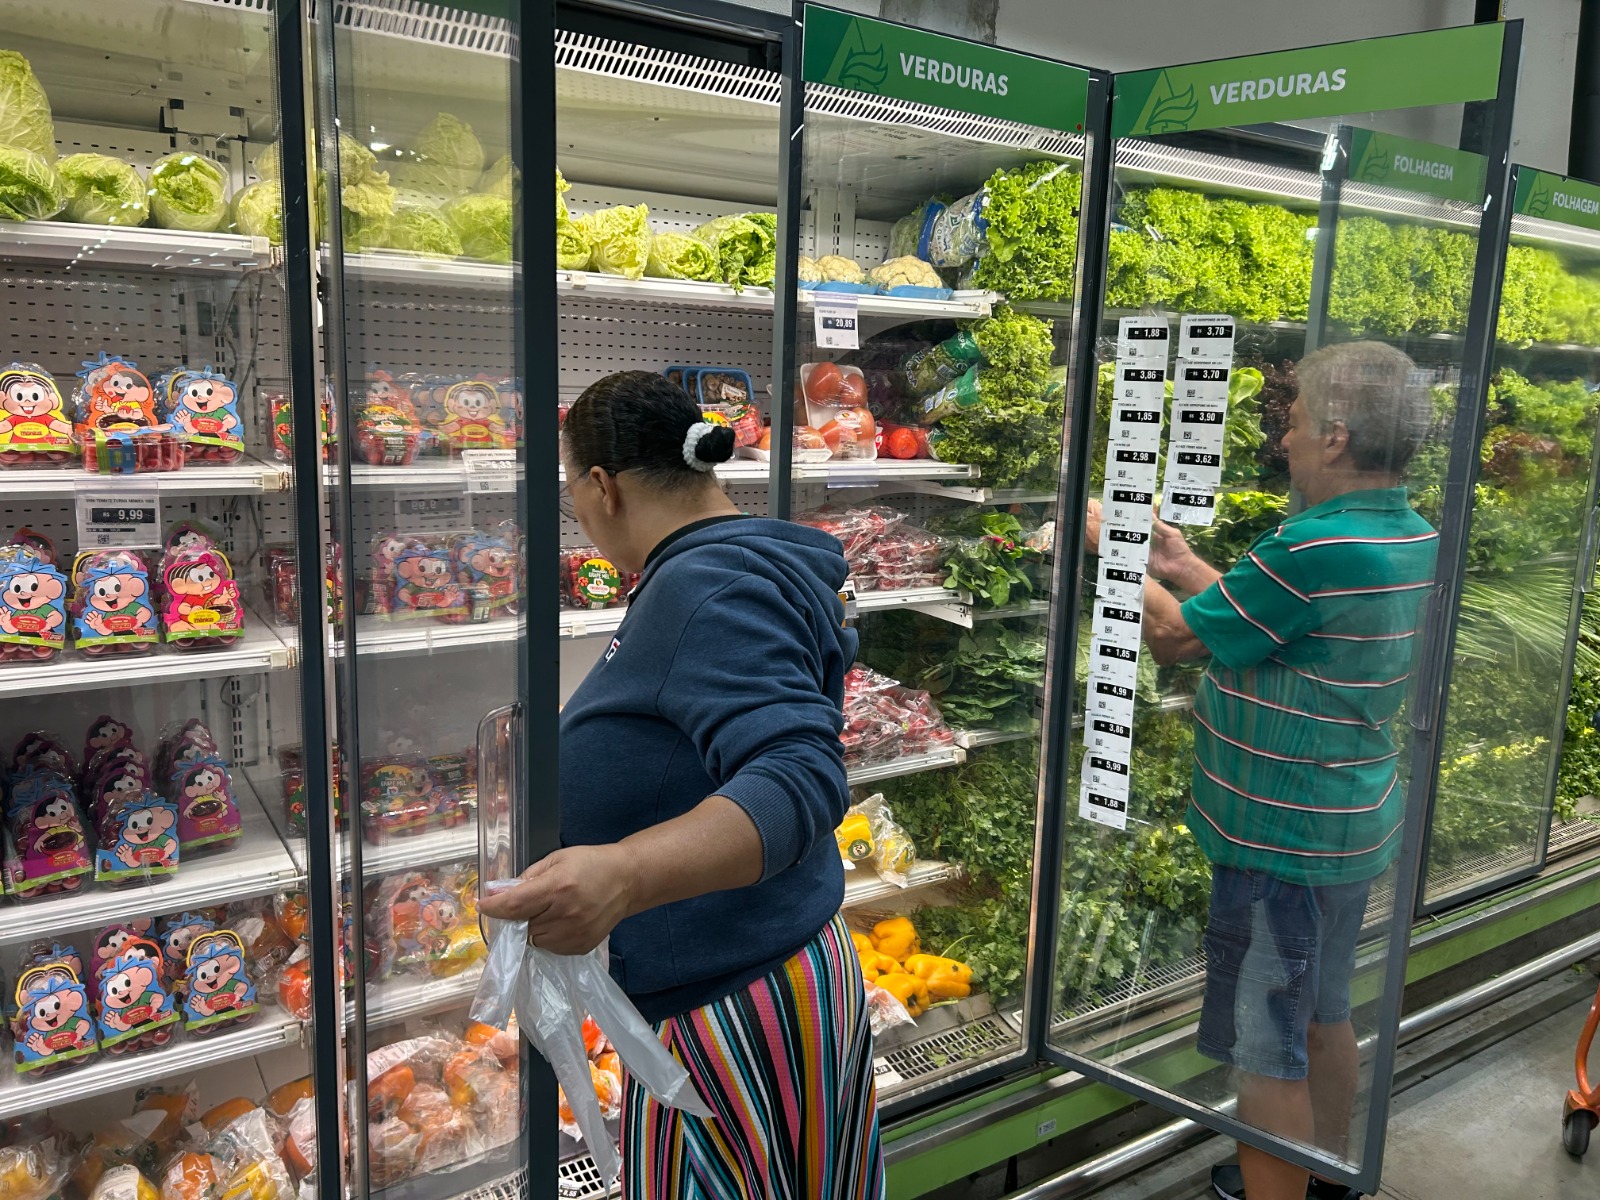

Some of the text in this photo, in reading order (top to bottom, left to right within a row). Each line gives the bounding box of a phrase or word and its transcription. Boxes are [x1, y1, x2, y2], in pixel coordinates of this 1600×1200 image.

[899, 52, 1009, 97] VERDURAS
[1209, 69, 1347, 105] VERDURAS
[1393, 154, 1454, 181] FOLHAGEM
[1552, 191, 1599, 215] FOLHAGEM
[835, 318, 852, 328] 20,89
[1144, 328, 1160, 338] 1,88
[1207, 326, 1225, 336] 3,70
[1139, 371, 1156, 380] 3,86
[1202, 370, 1220, 379] 3,70
[1137, 412, 1153, 422] 1,85
[1199, 412, 1216, 422] 3,90
[1132, 452, 1149, 462] 2,98
[1195, 454, 1212, 464] 3,62
[1129, 492, 1145, 502] 1,85
[118, 509, 143, 521] 9,99
[1125, 532, 1141, 542] 4,29
[1122, 572, 1137, 581] 1,85
[1119, 610, 1134, 619] 1,85
[1115, 649, 1130, 659] 1,85
[1112, 686, 1127, 696] 4,99
[1109, 724, 1124, 734] 3,86
[1105, 761, 1121, 771] 5,99
[1103, 798, 1118, 808] 1,88
